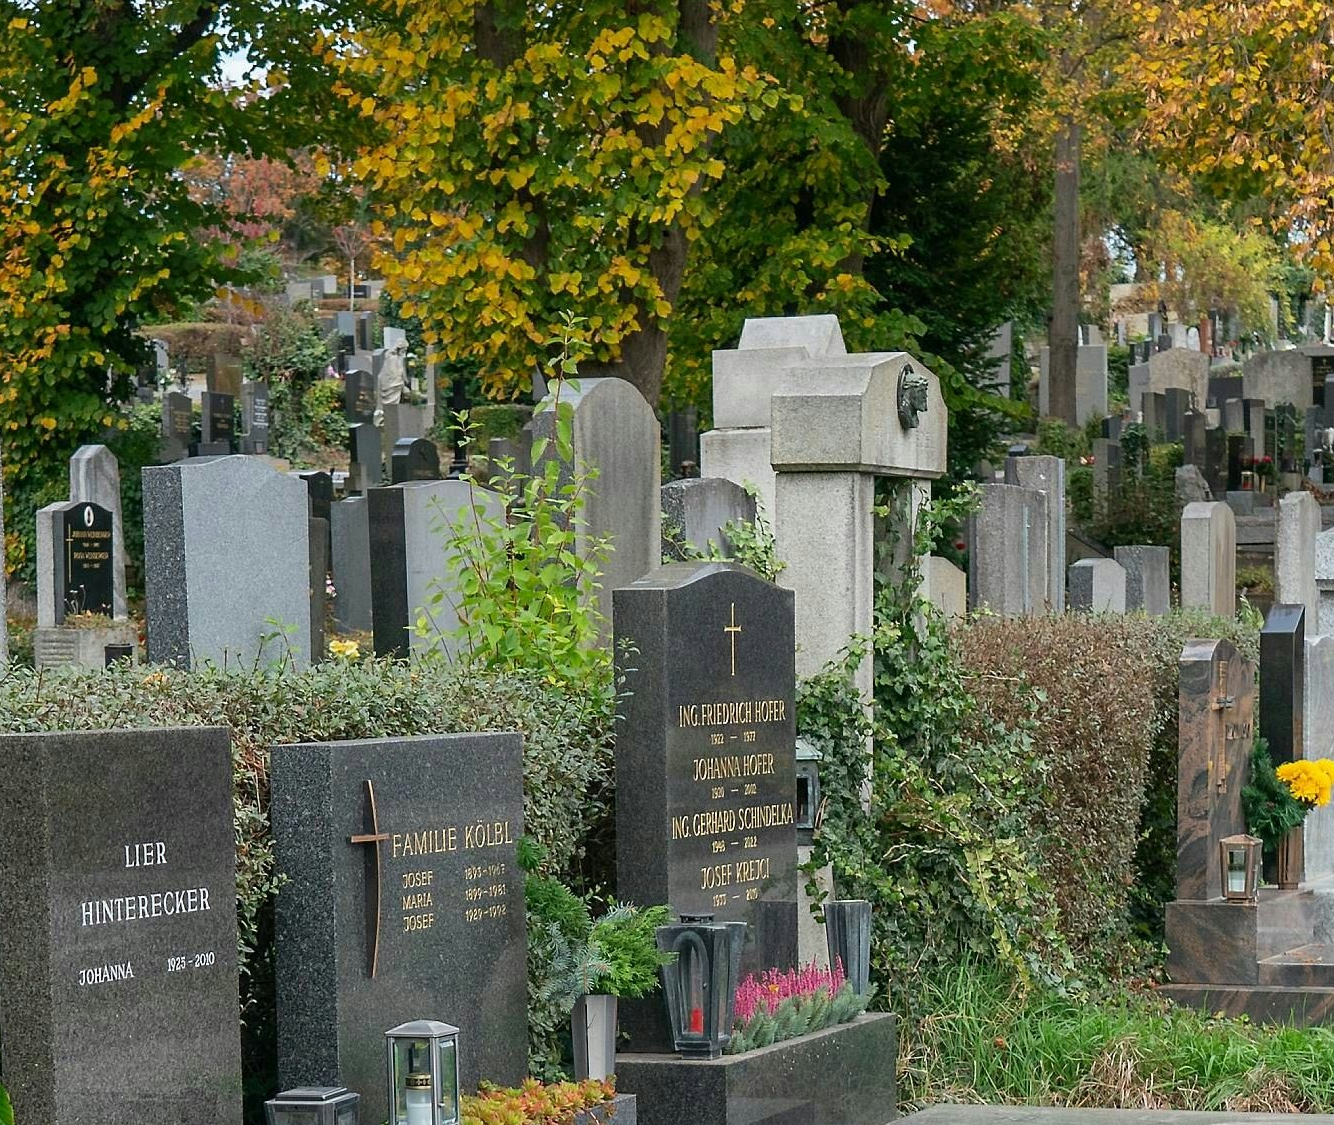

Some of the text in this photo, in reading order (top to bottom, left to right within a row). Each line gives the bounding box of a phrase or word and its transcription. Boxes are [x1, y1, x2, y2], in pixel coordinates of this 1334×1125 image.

[701, 702, 751, 726] FRIEDRICH
[755, 700, 786, 722] HOFER
[711, 734, 724, 745] 1922
[693, 753, 775, 781] JOHANNA HOFER
[672, 802, 793, 839] ING. GERHARD SCHINDELKA
[393, 820, 513, 857] FAMILIE KÖLBL
[125, 842, 167, 867] LIER
[402, 870, 433, 888] JOSEF
[701, 858, 769, 889] JOSEF KREJCI
[81, 887, 211, 926] HINTERECKER
[402, 892, 433, 910] MARIA
[403, 913, 434, 932] JOSEF
[79, 961, 135, 985] JOHANNA
